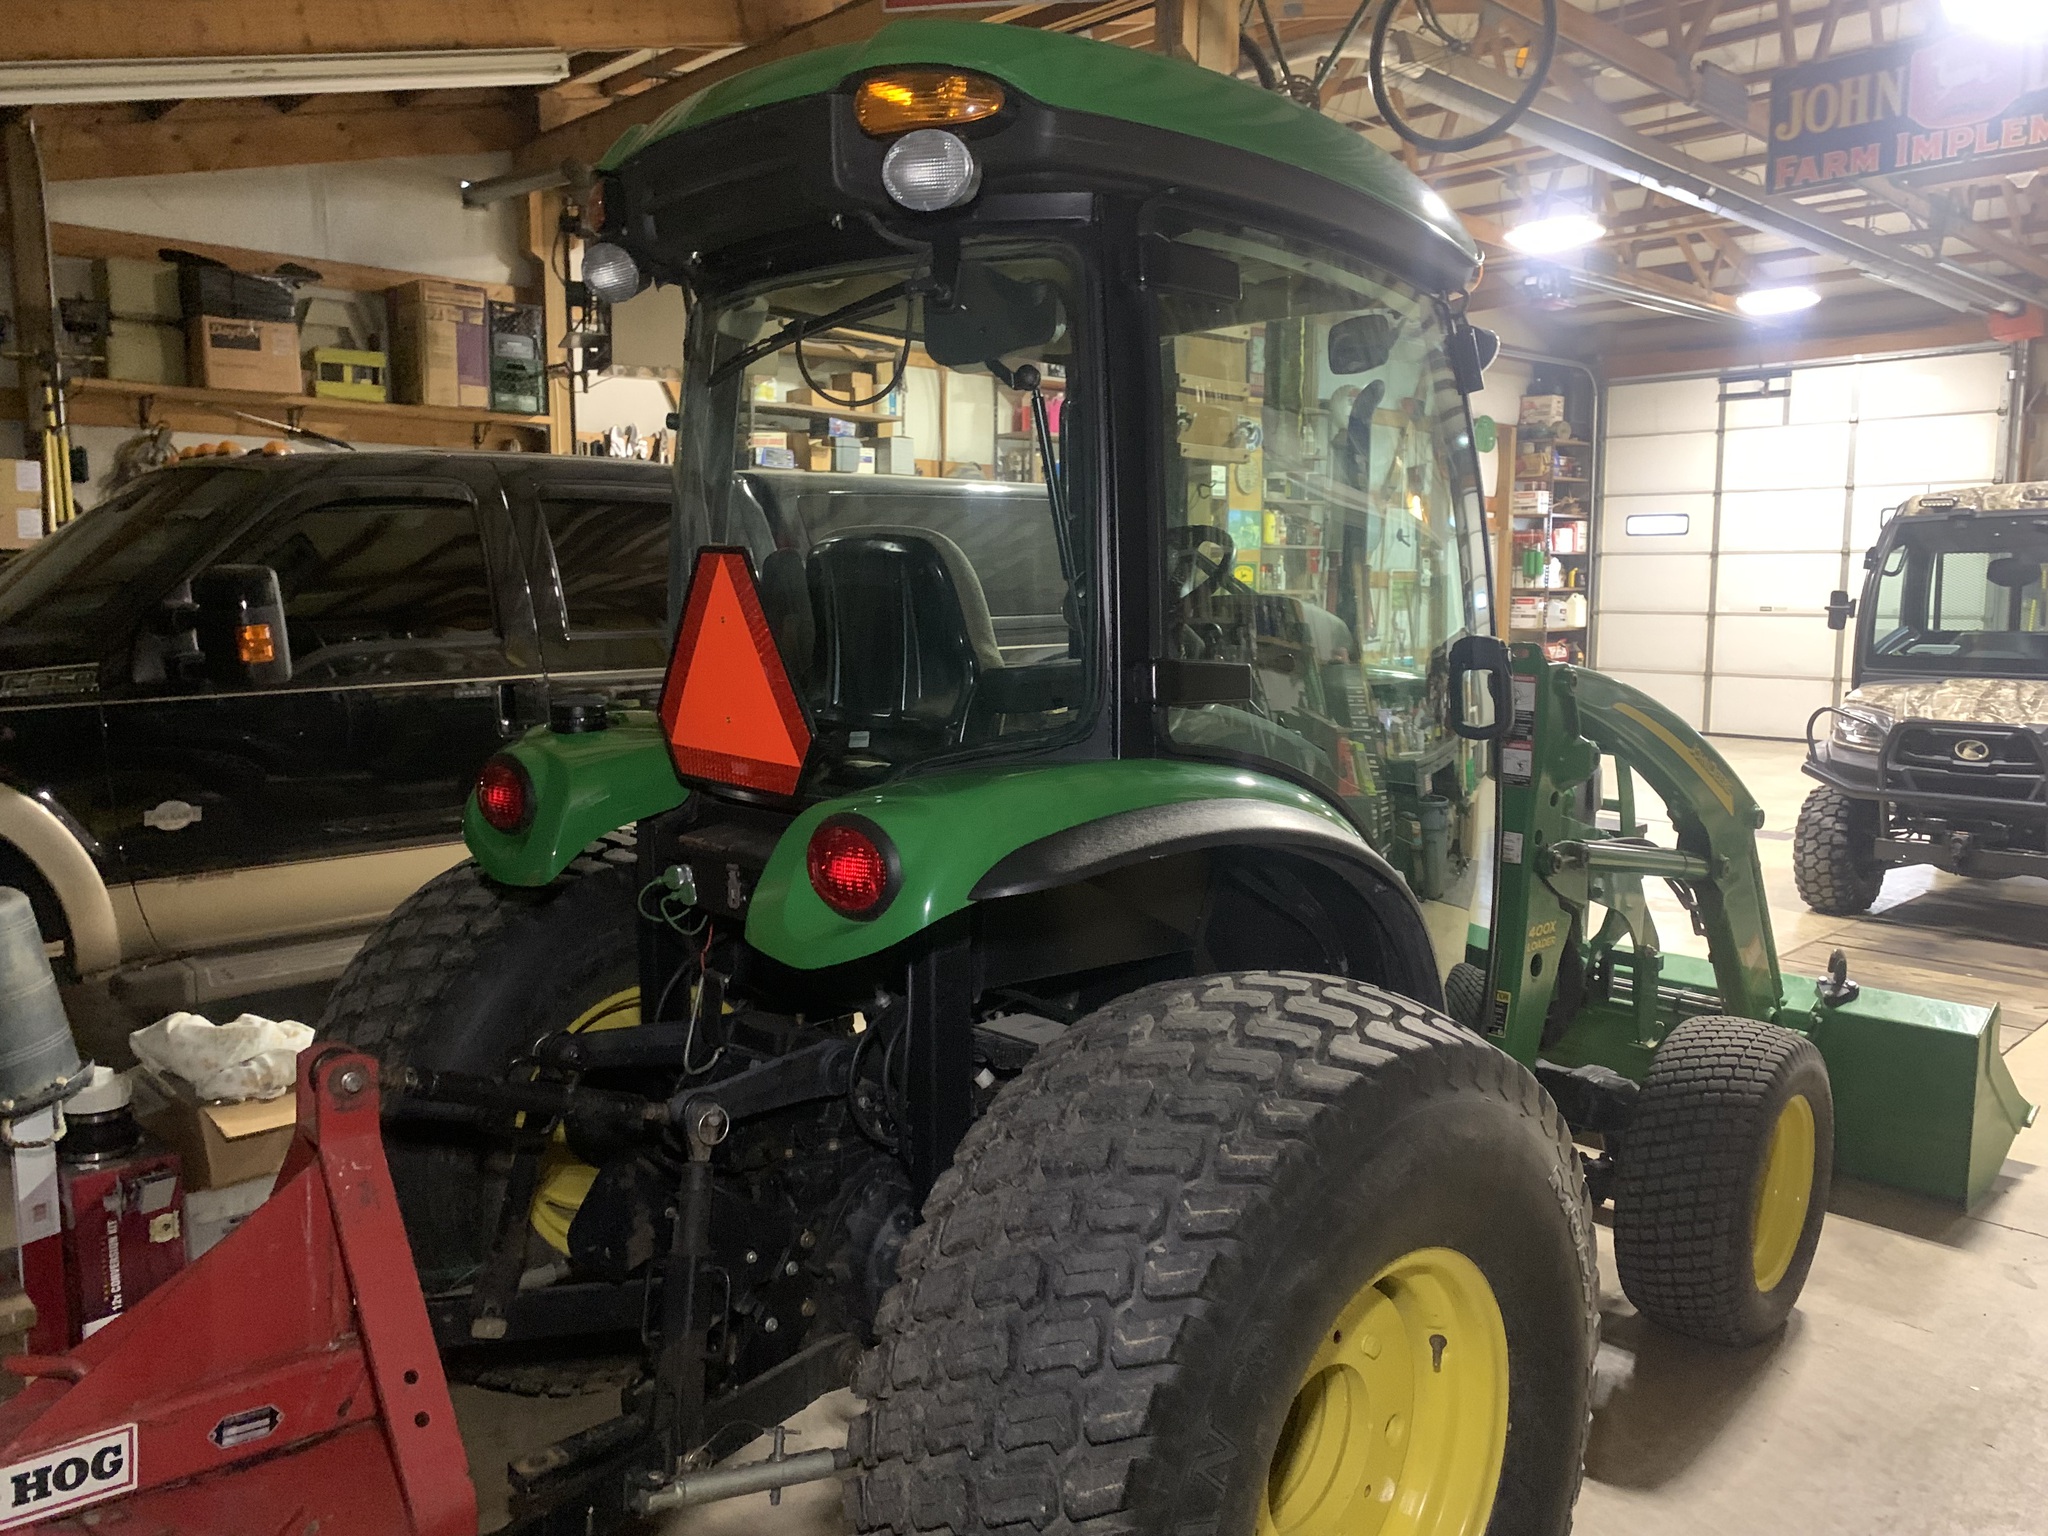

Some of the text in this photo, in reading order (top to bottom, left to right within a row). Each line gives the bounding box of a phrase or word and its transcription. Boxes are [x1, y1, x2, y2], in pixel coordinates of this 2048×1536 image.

[1775, 65, 1908, 142] JOHN
[1774, 143, 1881, 190] FARM
[1525, 936, 1557, 953] LOADER
[1528, 920, 1557, 938] 400X
[107, 1235, 122, 1293] CONVERSION
[11, 1443, 124, 1508] HOG
